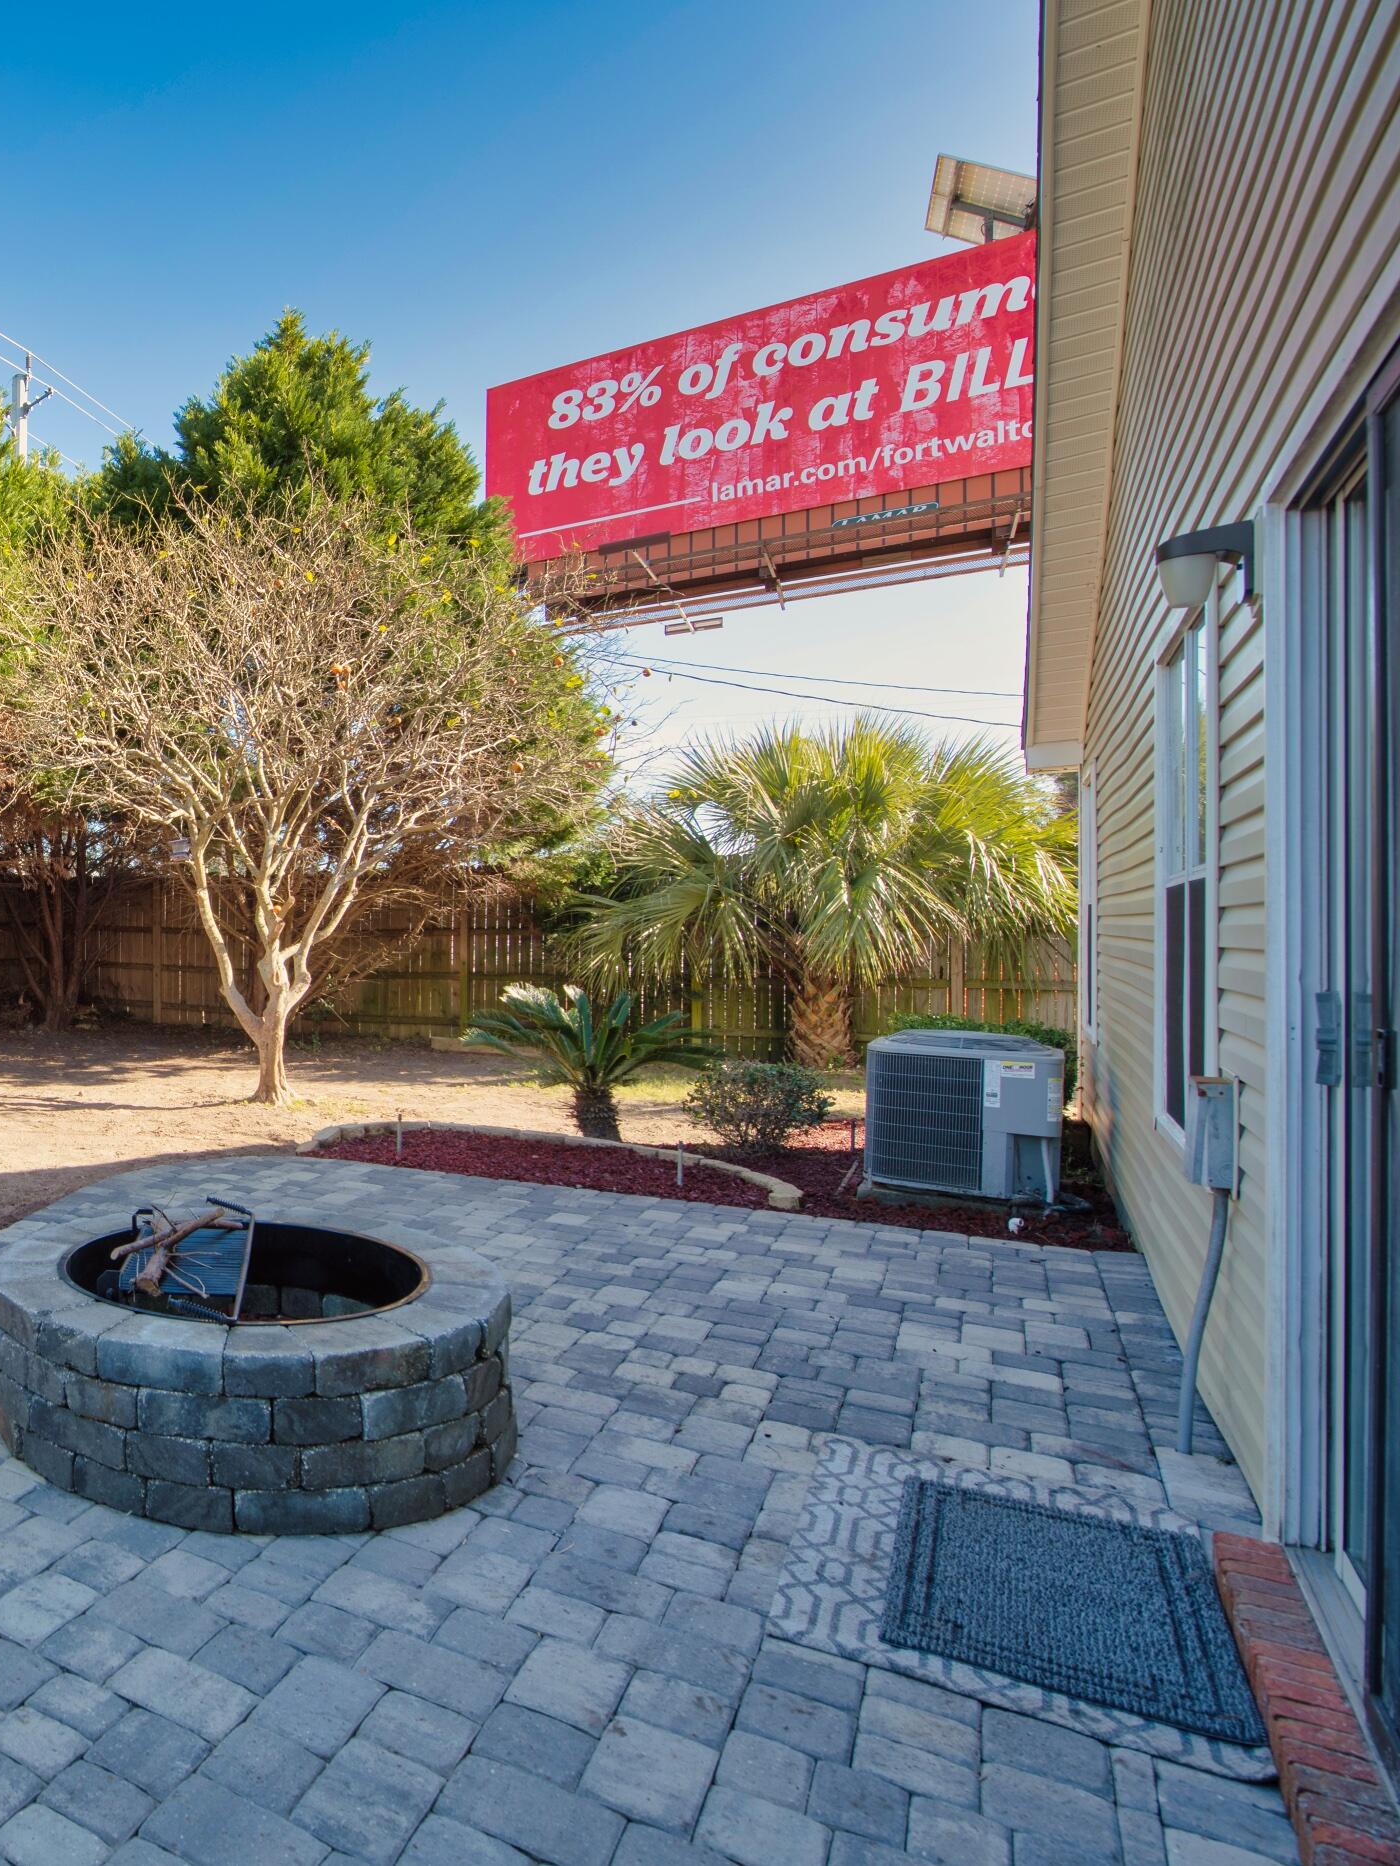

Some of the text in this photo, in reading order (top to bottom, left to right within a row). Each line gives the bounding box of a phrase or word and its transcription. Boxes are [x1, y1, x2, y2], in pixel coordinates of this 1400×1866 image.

[548, 275, 1036, 430] 83% of consum
[527, 442, 645, 496] they
[659, 400, 794, 466] look
[808, 378, 879, 432] at
